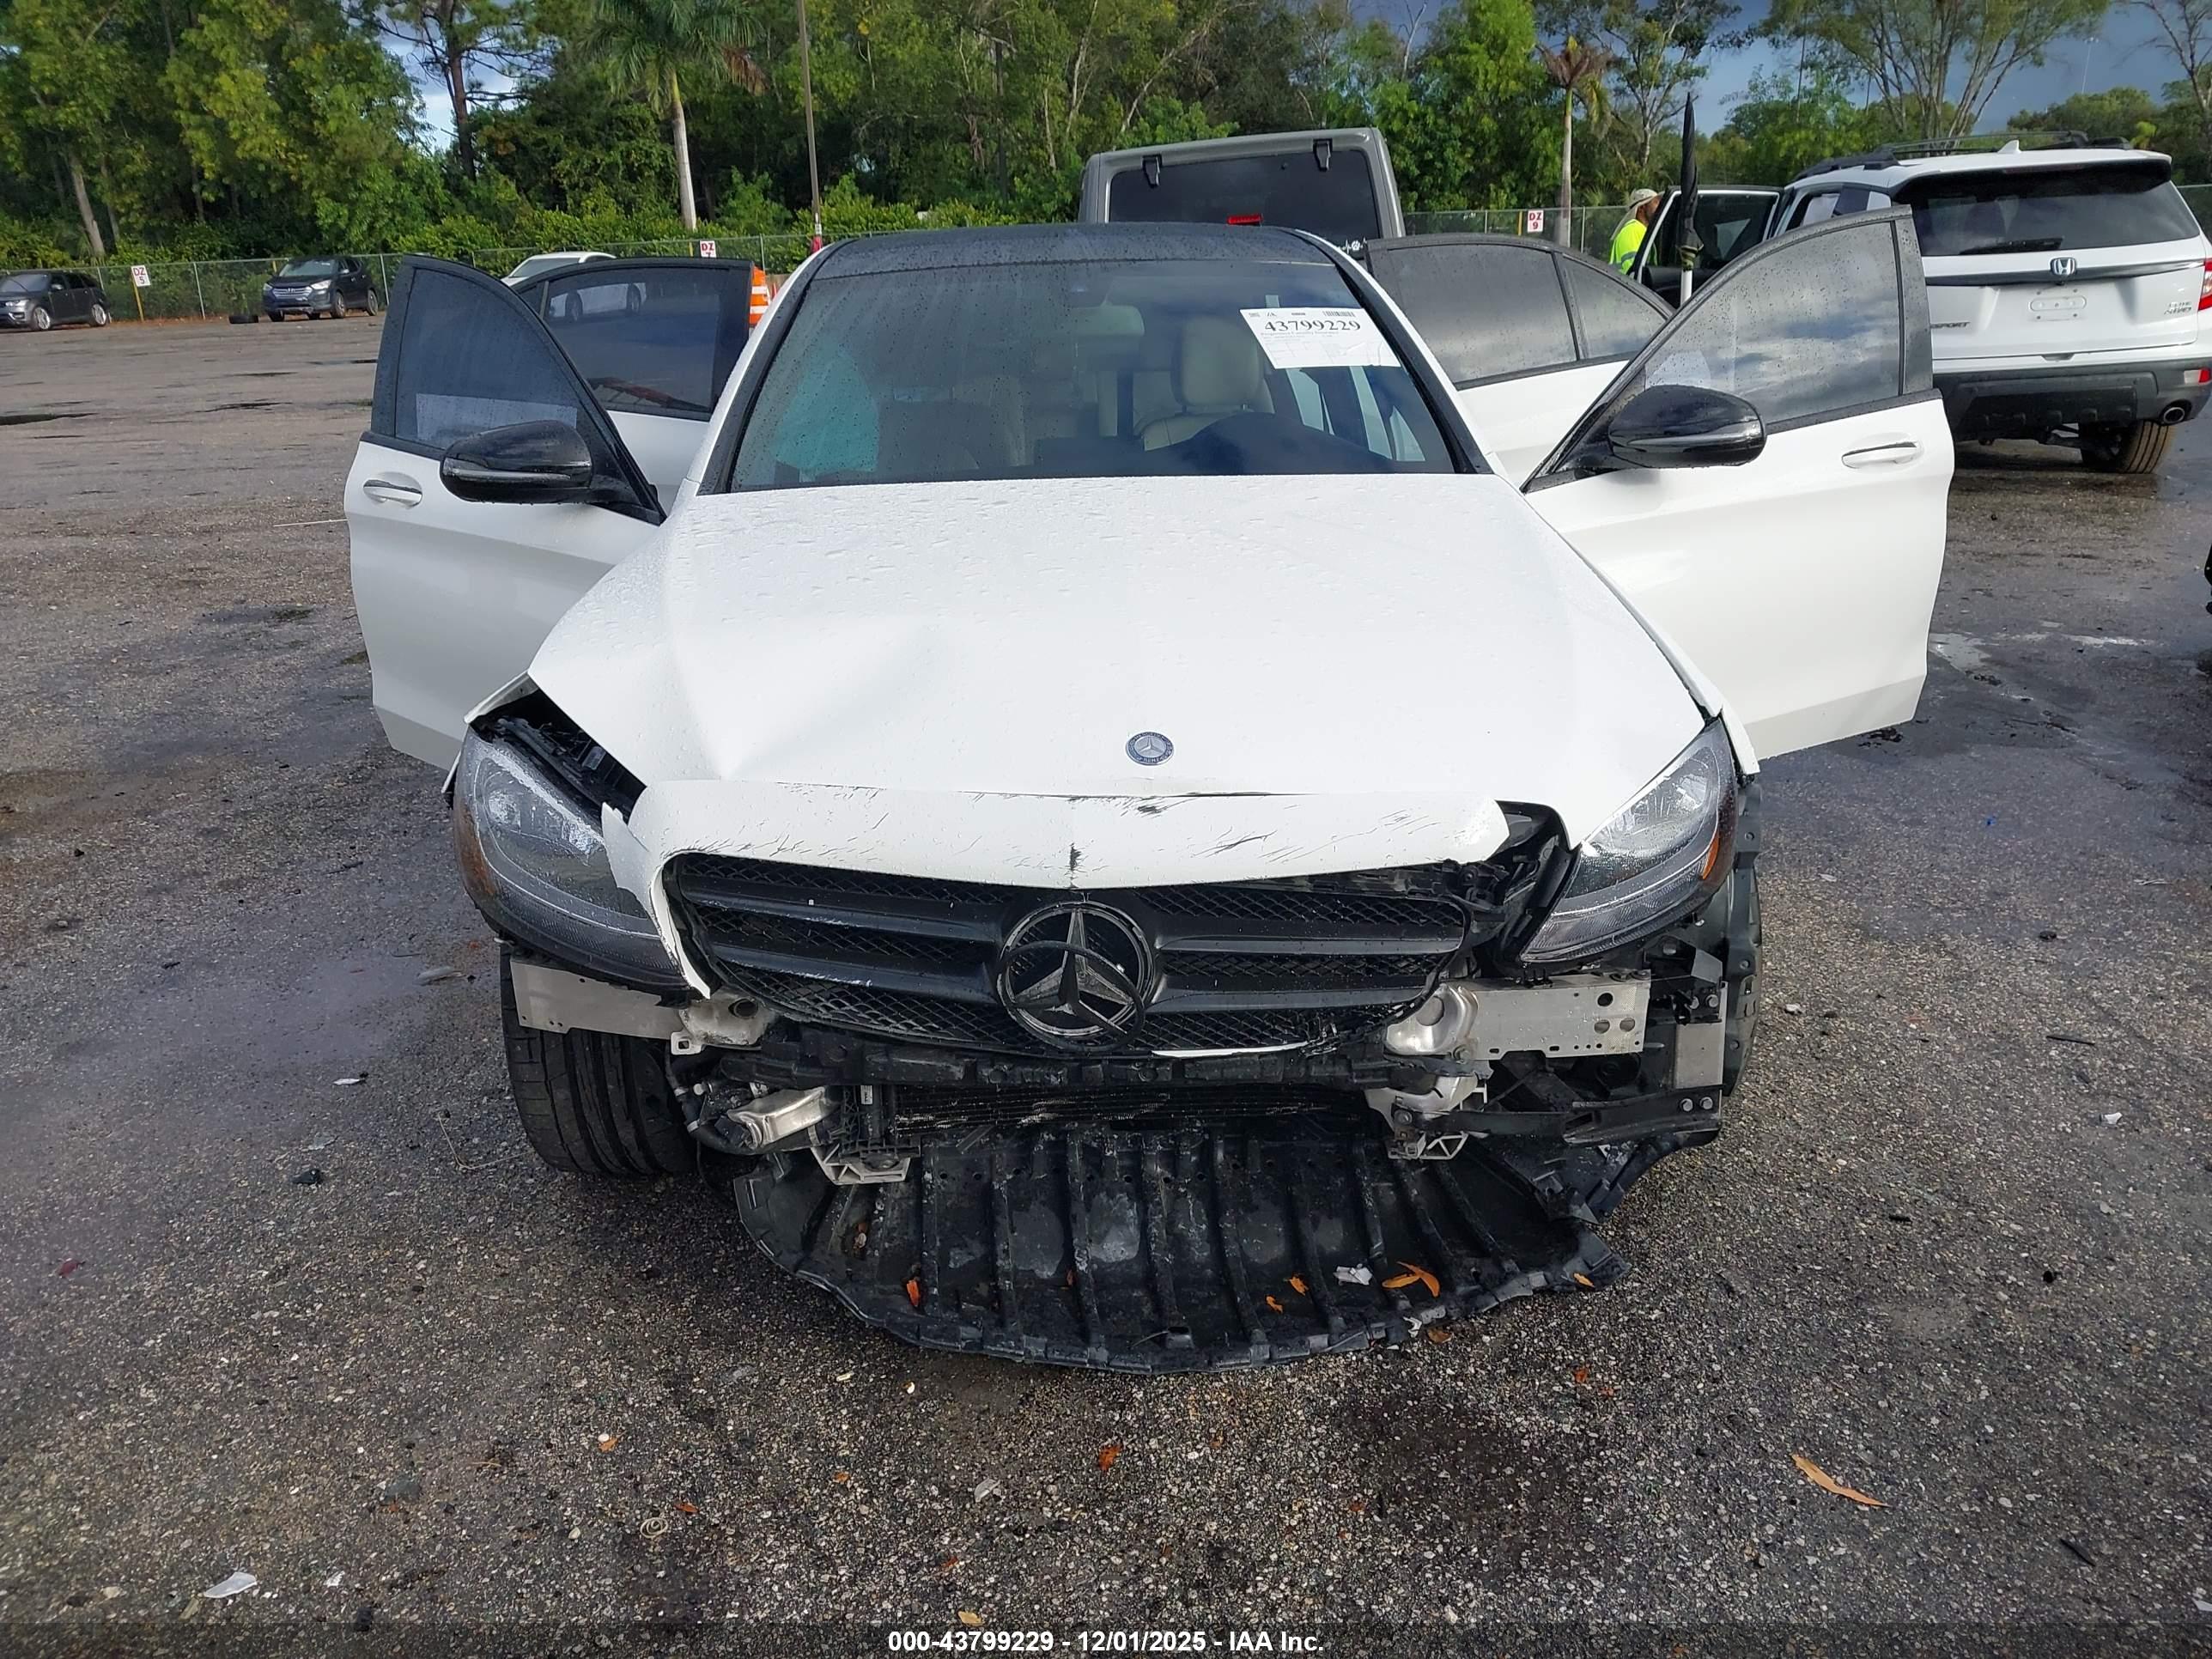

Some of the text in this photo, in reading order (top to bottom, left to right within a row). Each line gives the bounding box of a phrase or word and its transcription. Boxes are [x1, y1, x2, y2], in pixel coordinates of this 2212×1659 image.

[1529, 212, 1542, 221] DZ
[701, 242, 714, 251] DZ
[132, 267, 146, 276] DZ
[1264, 319, 1361, 331] 43799229
